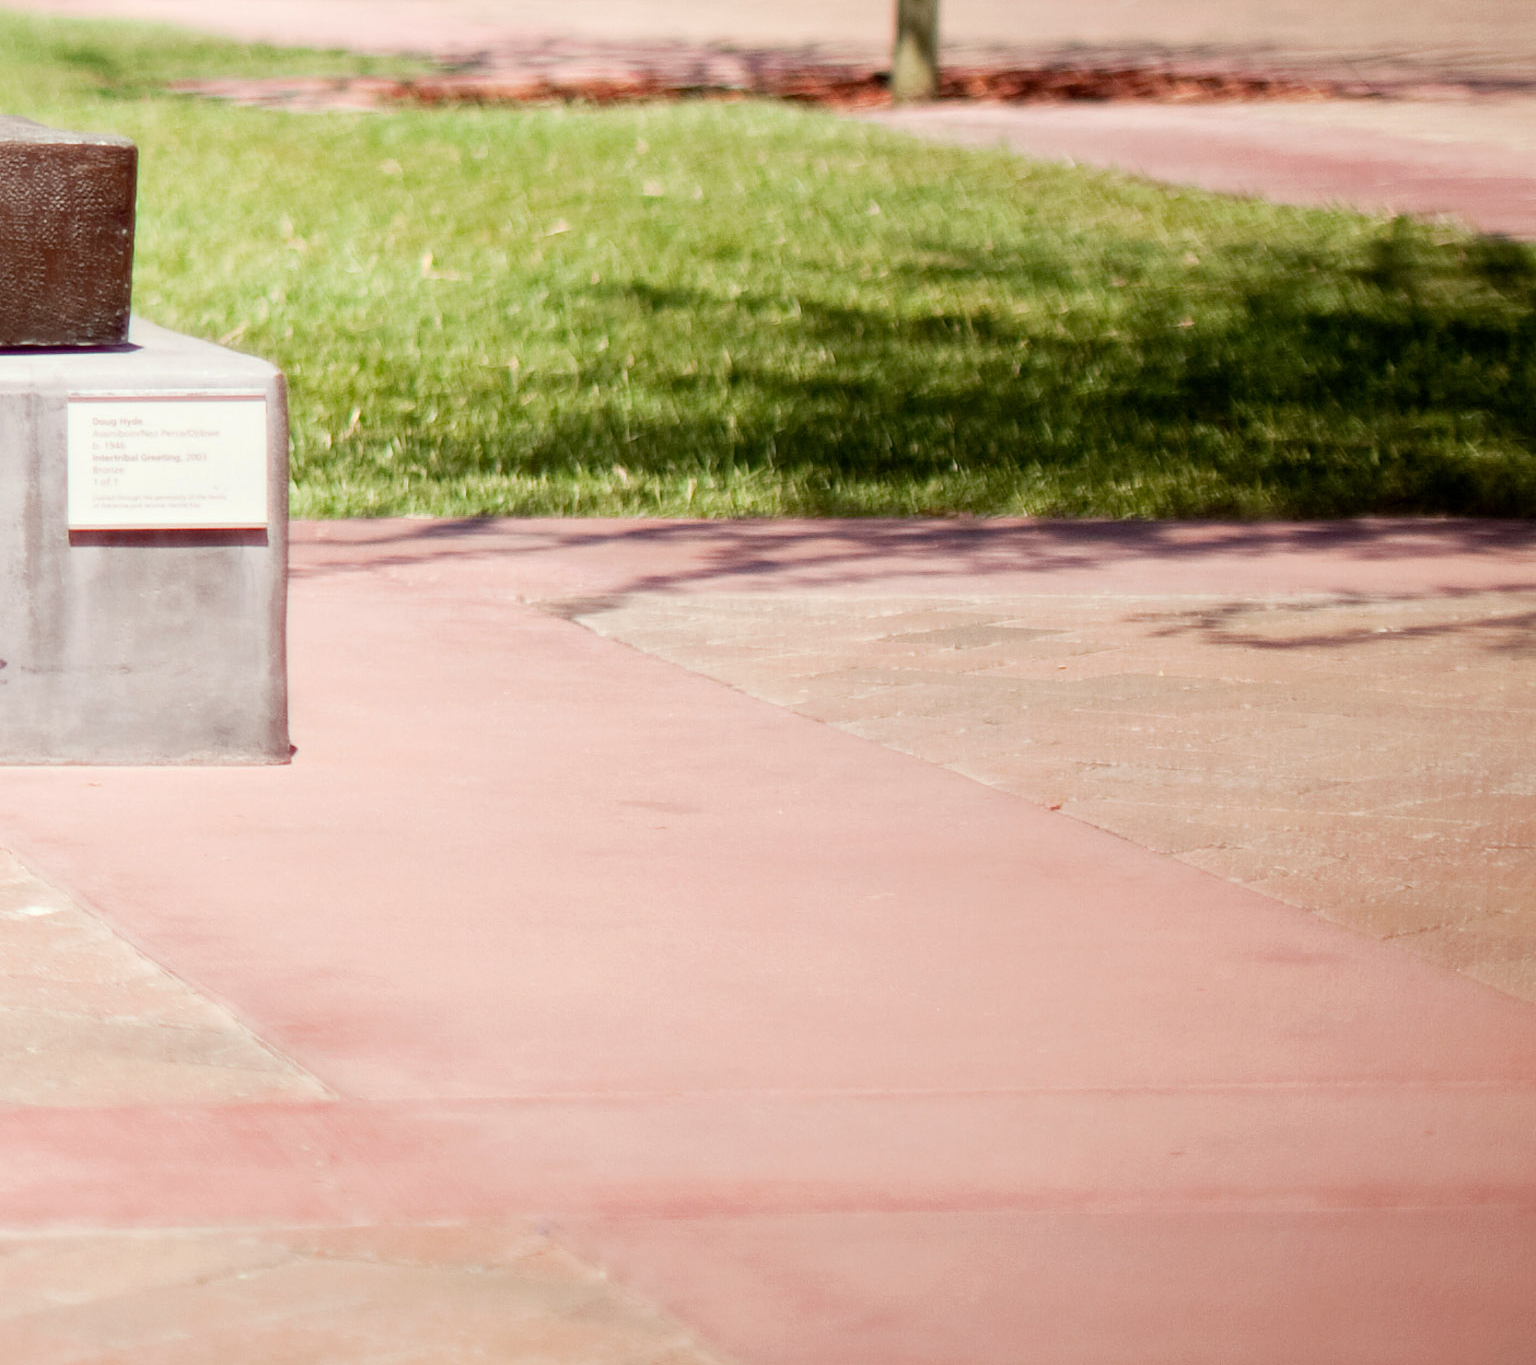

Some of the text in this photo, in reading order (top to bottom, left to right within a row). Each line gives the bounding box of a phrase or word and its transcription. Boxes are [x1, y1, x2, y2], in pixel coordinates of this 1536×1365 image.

[92, 417, 144, 427] Doug Hyde
[92, 453, 139, 462] Intertribal
[92, 466, 125, 475] Bronze
